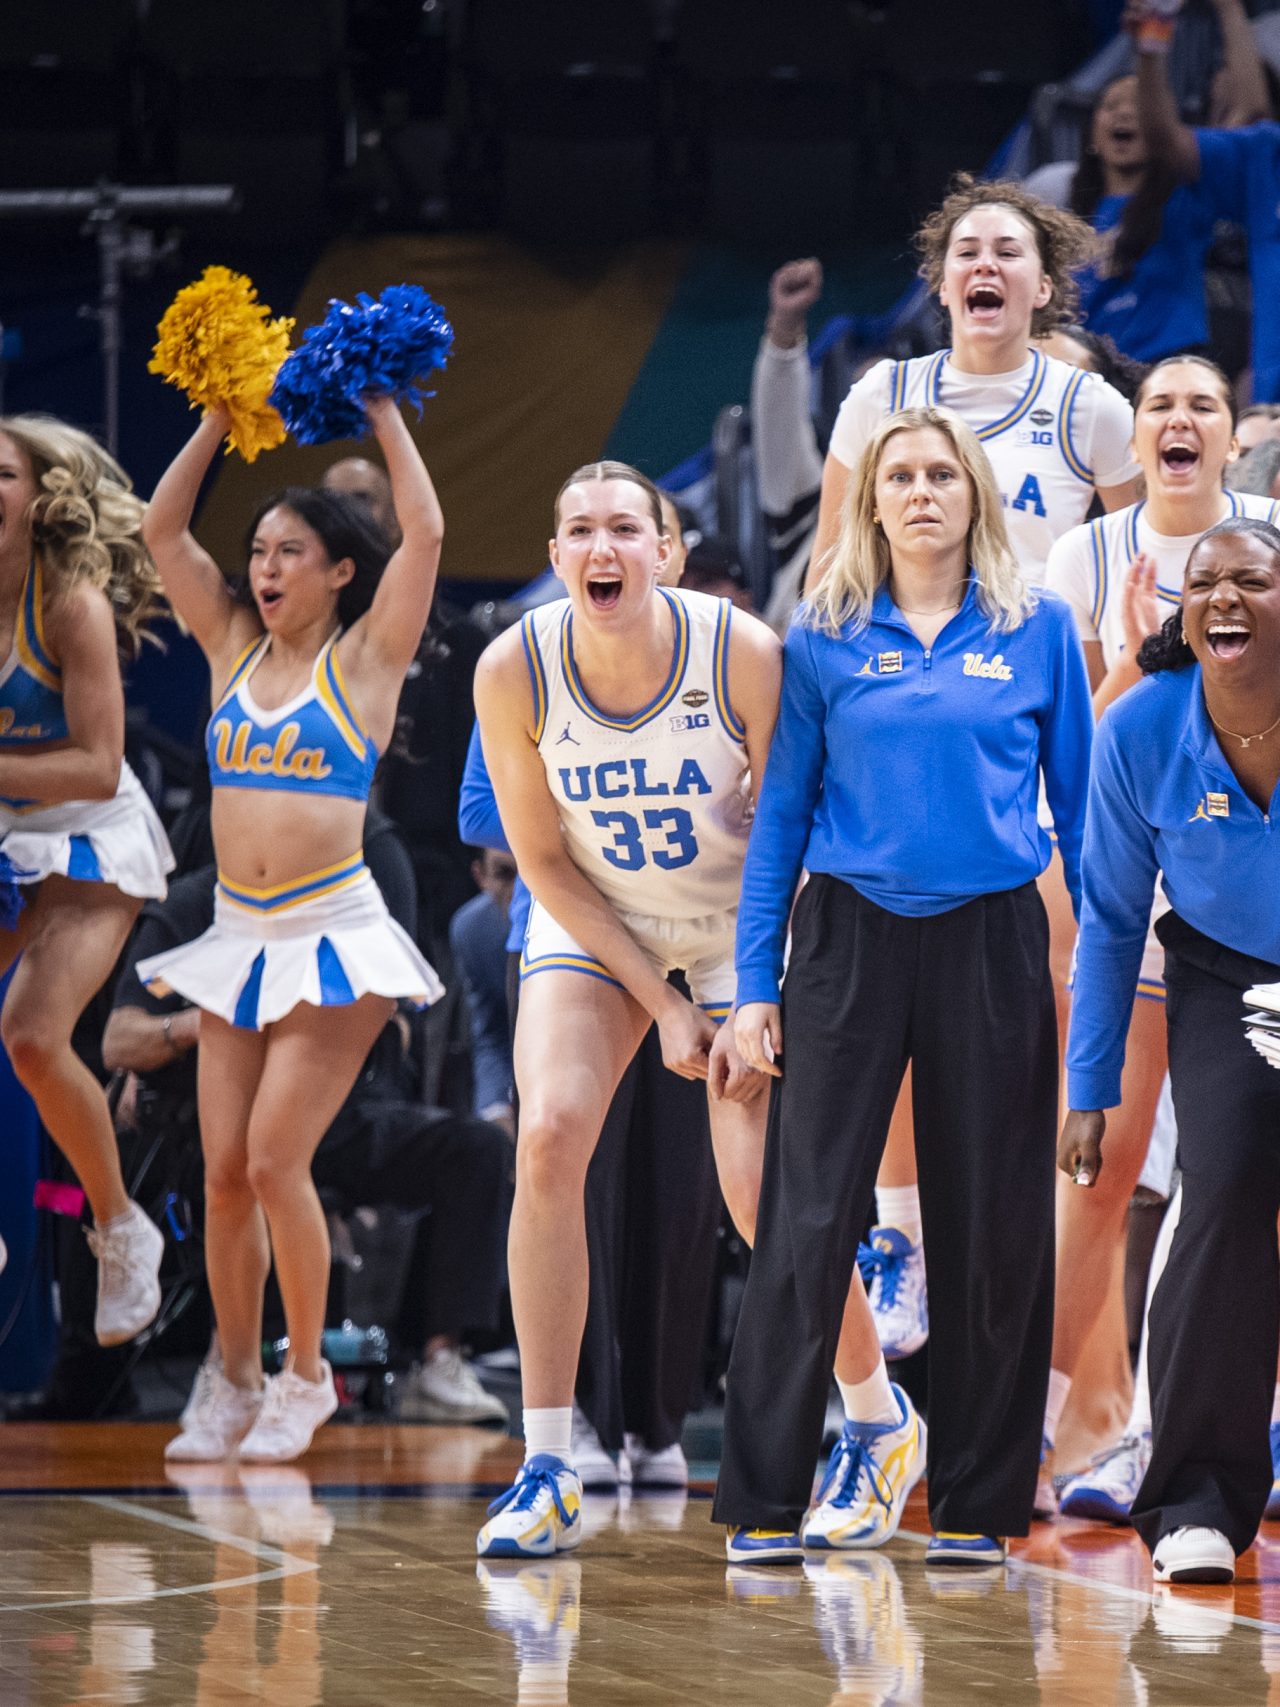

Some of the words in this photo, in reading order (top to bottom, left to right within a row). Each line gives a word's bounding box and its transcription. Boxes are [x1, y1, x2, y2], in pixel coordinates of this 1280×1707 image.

[962, 652, 1014, 681] Ucla
[213, 718, 333, 780] Ucla
[558, 758, 712, 801] UCLA
[590, 807, 699, 871] 33
